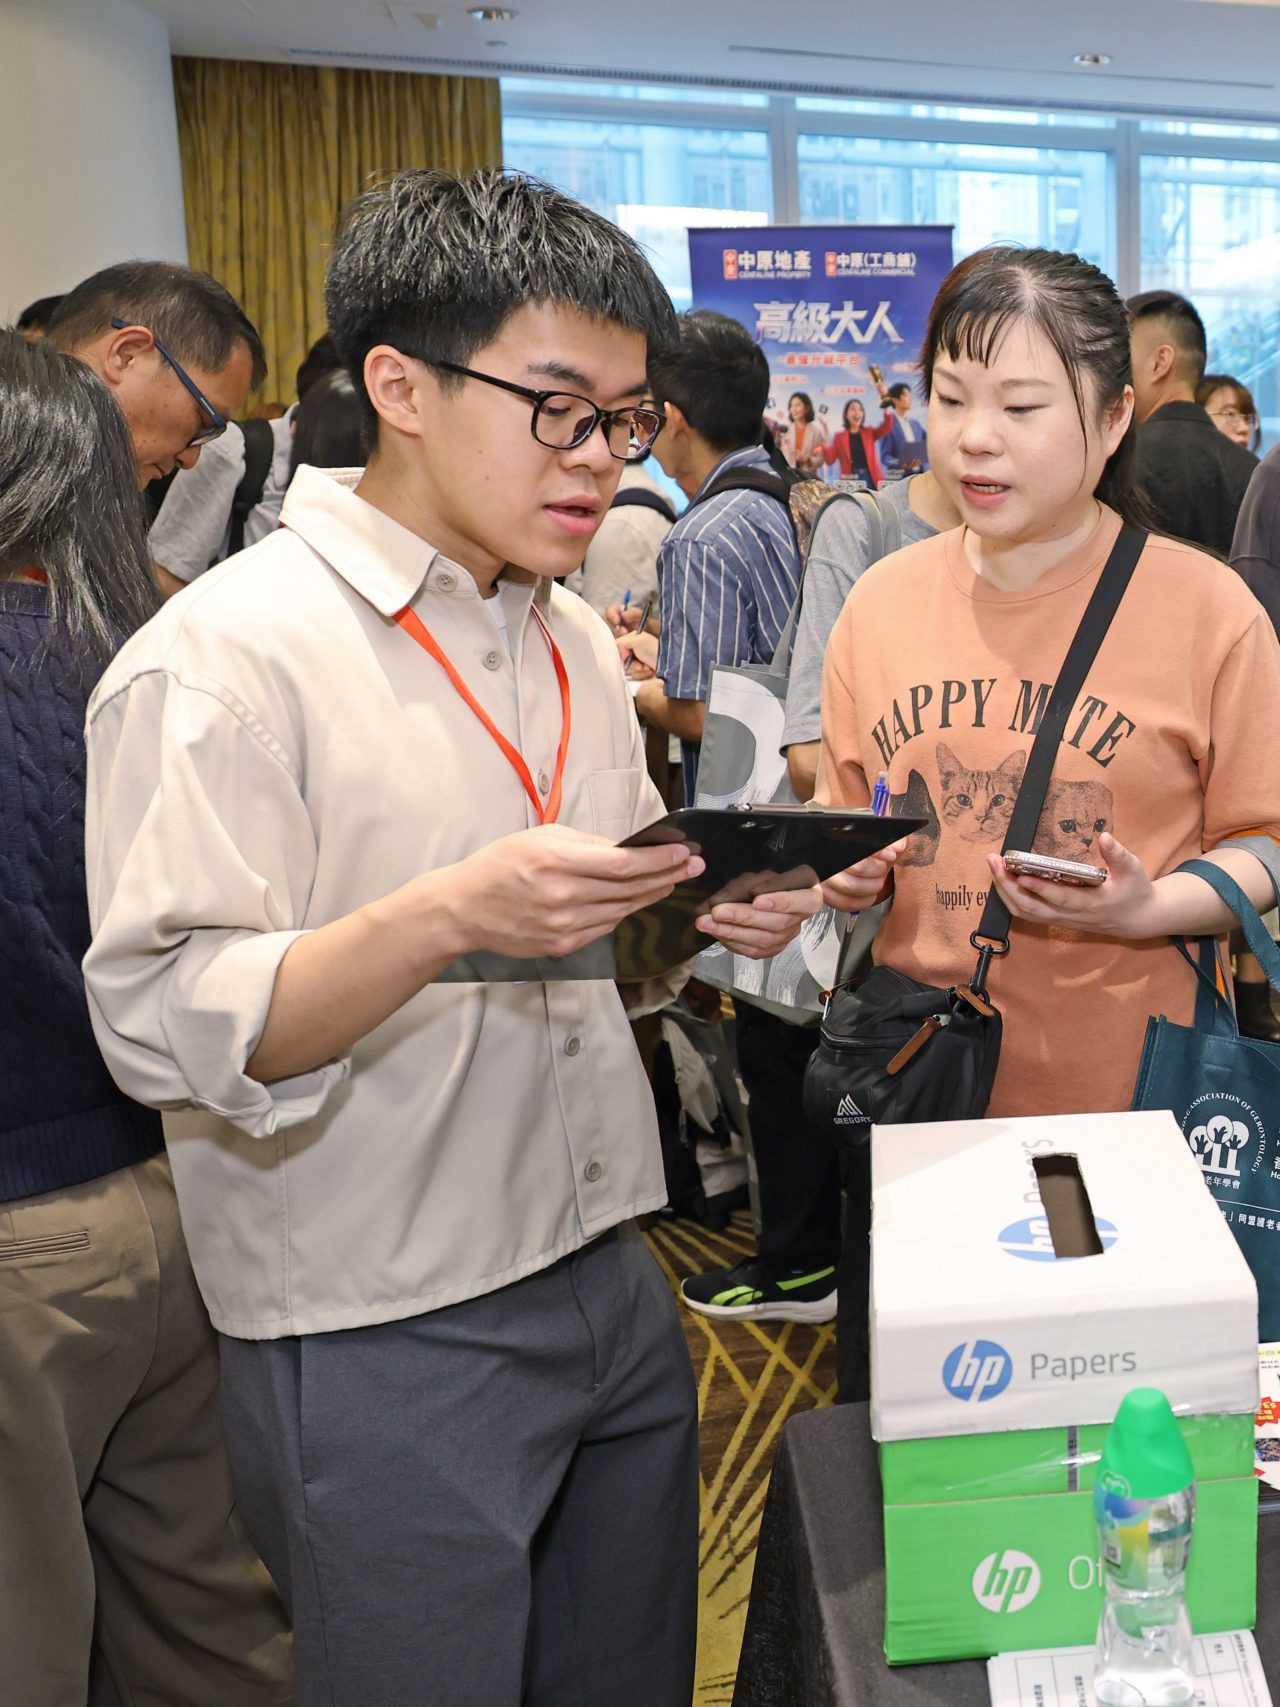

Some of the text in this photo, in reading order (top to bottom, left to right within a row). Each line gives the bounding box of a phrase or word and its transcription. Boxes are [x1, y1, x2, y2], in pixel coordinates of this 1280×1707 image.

[738, 250, 812, 271] 中原地產
[753, 300, 904, 344] 高級大人
[871, 678, 1136, 768] HAPPY MTE
[935, 883, 973, 911] happily
[833, 1116, 871, 1125] GREGORY
[1190, 1092, 1242, 1110] ASSOCIATION
[1240, 1100, 1252, 1111] OF
[1249, 1110, 1266, 1174] GERONTOLOGY
[945, 1340, 1137, 1400] hp Papers
[976, 1550, 1037, 1613] hp
